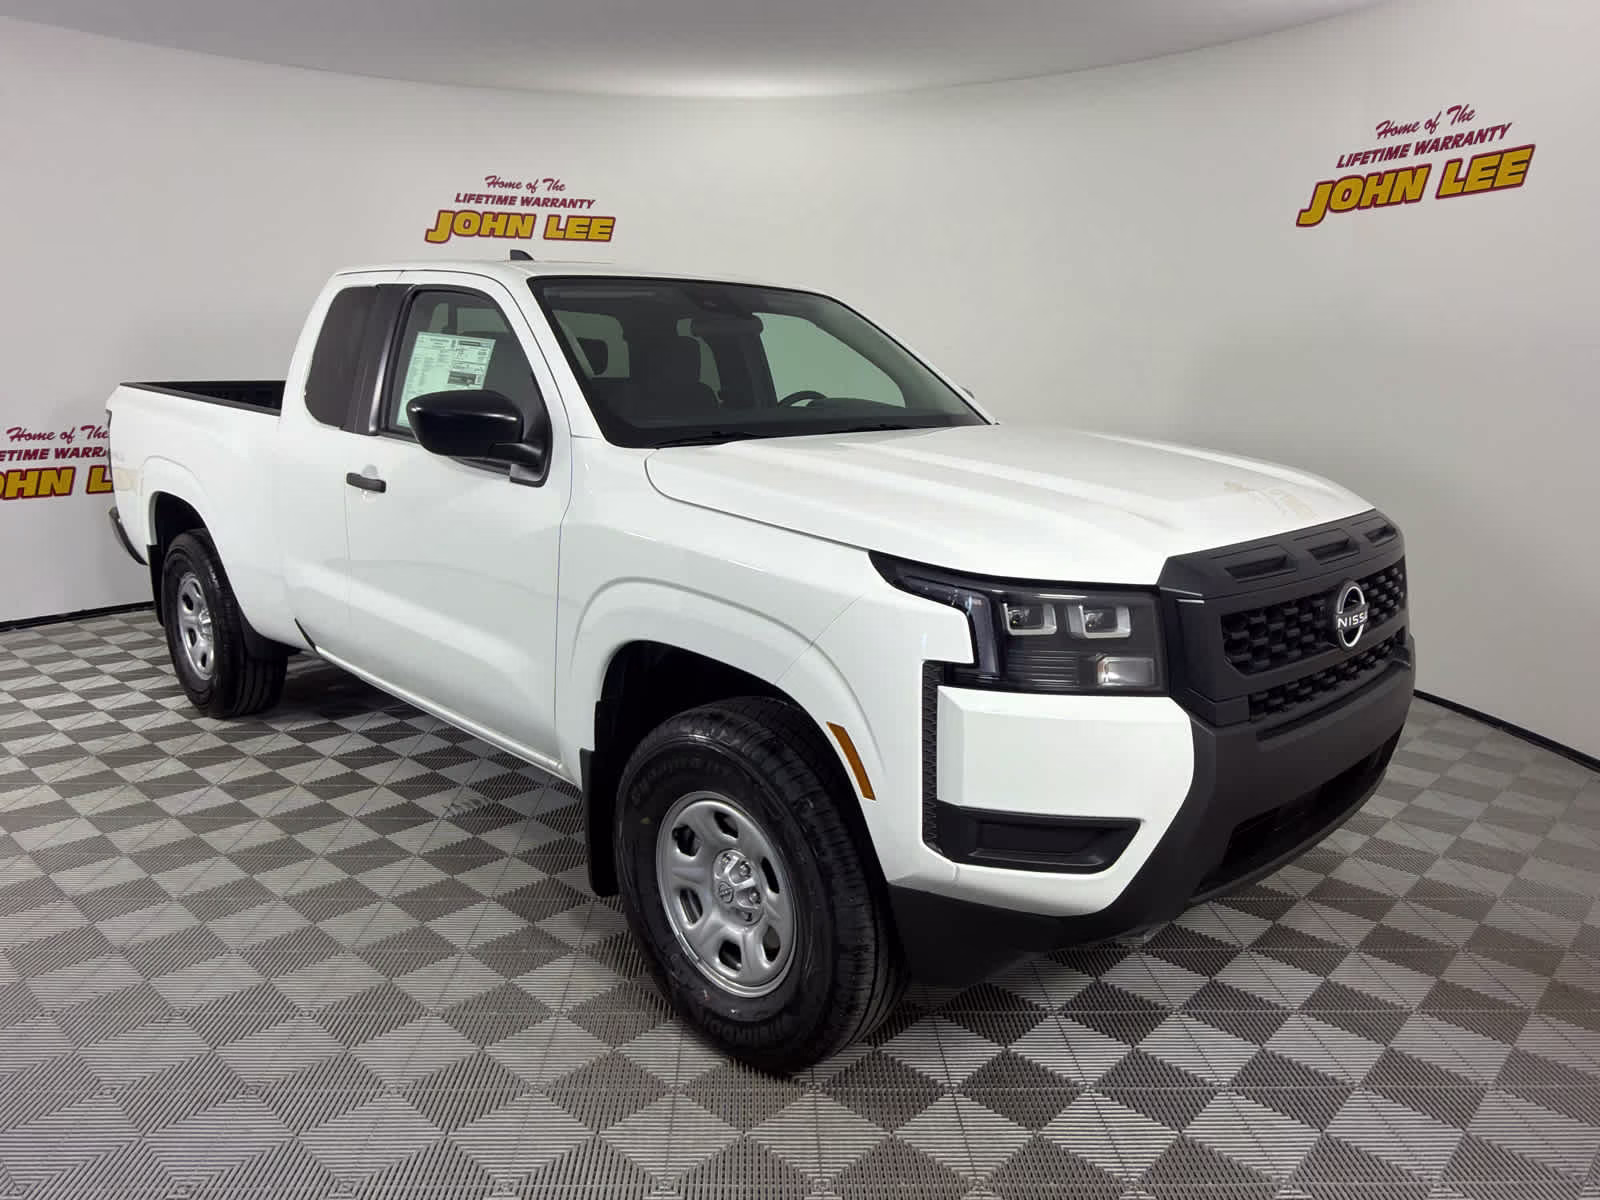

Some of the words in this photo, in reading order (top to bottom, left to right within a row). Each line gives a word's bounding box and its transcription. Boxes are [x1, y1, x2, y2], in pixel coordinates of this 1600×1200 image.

[1375, 120, 1420, 139] Home
[1424, 111, 1442, 134] of
[1447, 103, 1476, 126] The
[1336, 143, 1412, 168] LIFETIME
[1414, 122, 1512, 156] WARRANTY
[454, 192, 518, 206] LIFETIME
[520, 195, 596, 209] WARRANTY
[484, 175, 523, 190] Home
[526, 179, 539, 193] of
[542, 178, 566, 192] The
[1295, 163, 1432, 227] JOHN
[1435, 144, 1536, 199] LEE
[424, 209, 536, 244] JOHN
[543, 214, 616, 242] LEE
[6, 427, 56, 442] Home
[60, 427, 76, 444] of
[80, 425, 109, 440] The
